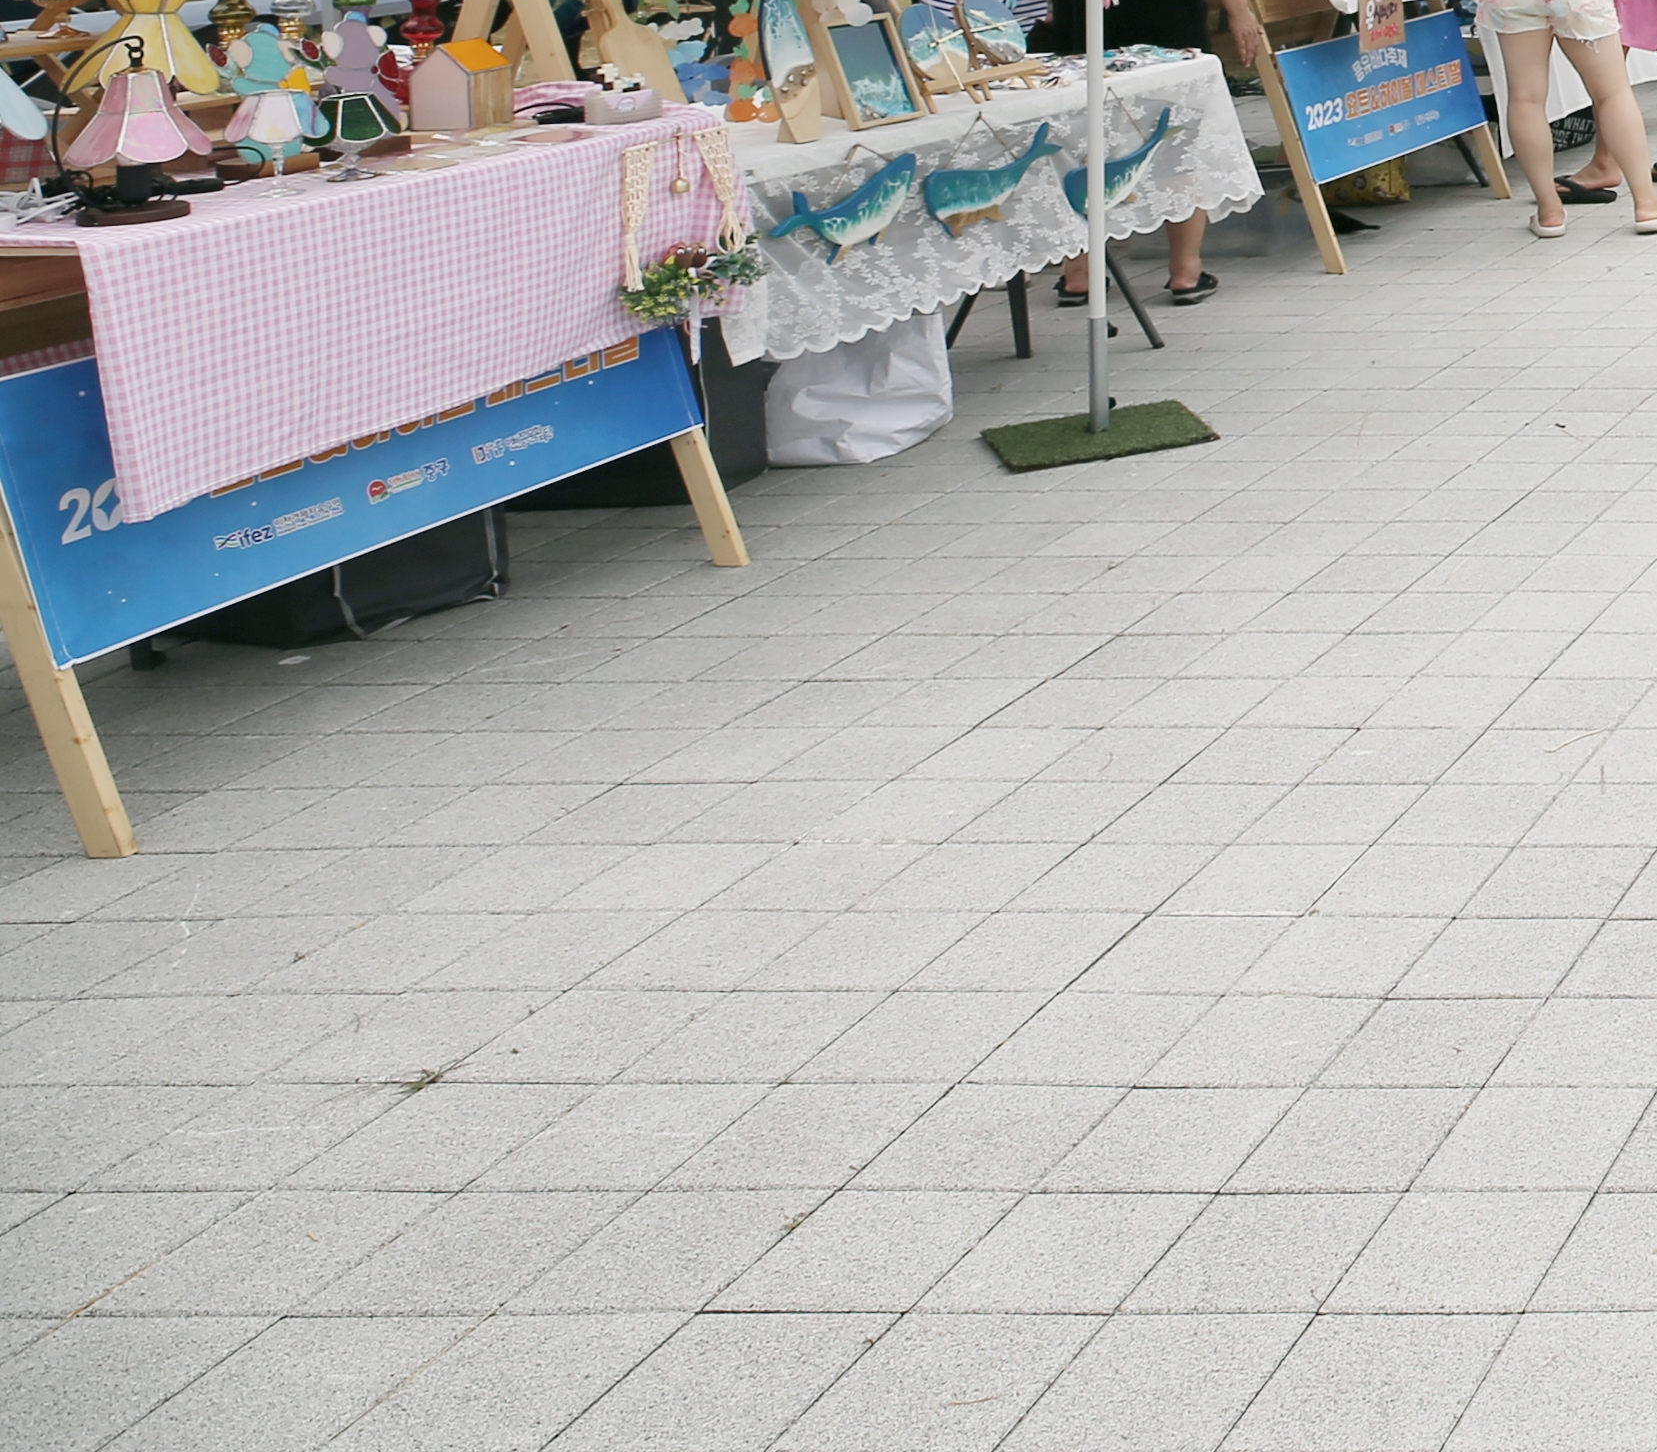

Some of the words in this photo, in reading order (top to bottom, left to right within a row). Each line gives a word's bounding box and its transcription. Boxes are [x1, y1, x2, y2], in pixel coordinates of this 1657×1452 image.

[1352, 48, 1408, 82] 용유바다축제
[1306, 97, 1343, 131] 2023
[1345, 74, 1414, 120] 요트&하이볼
[1414, 59, 1463, 98] 페스티벌
[238, 524, 274, 549] ifez
